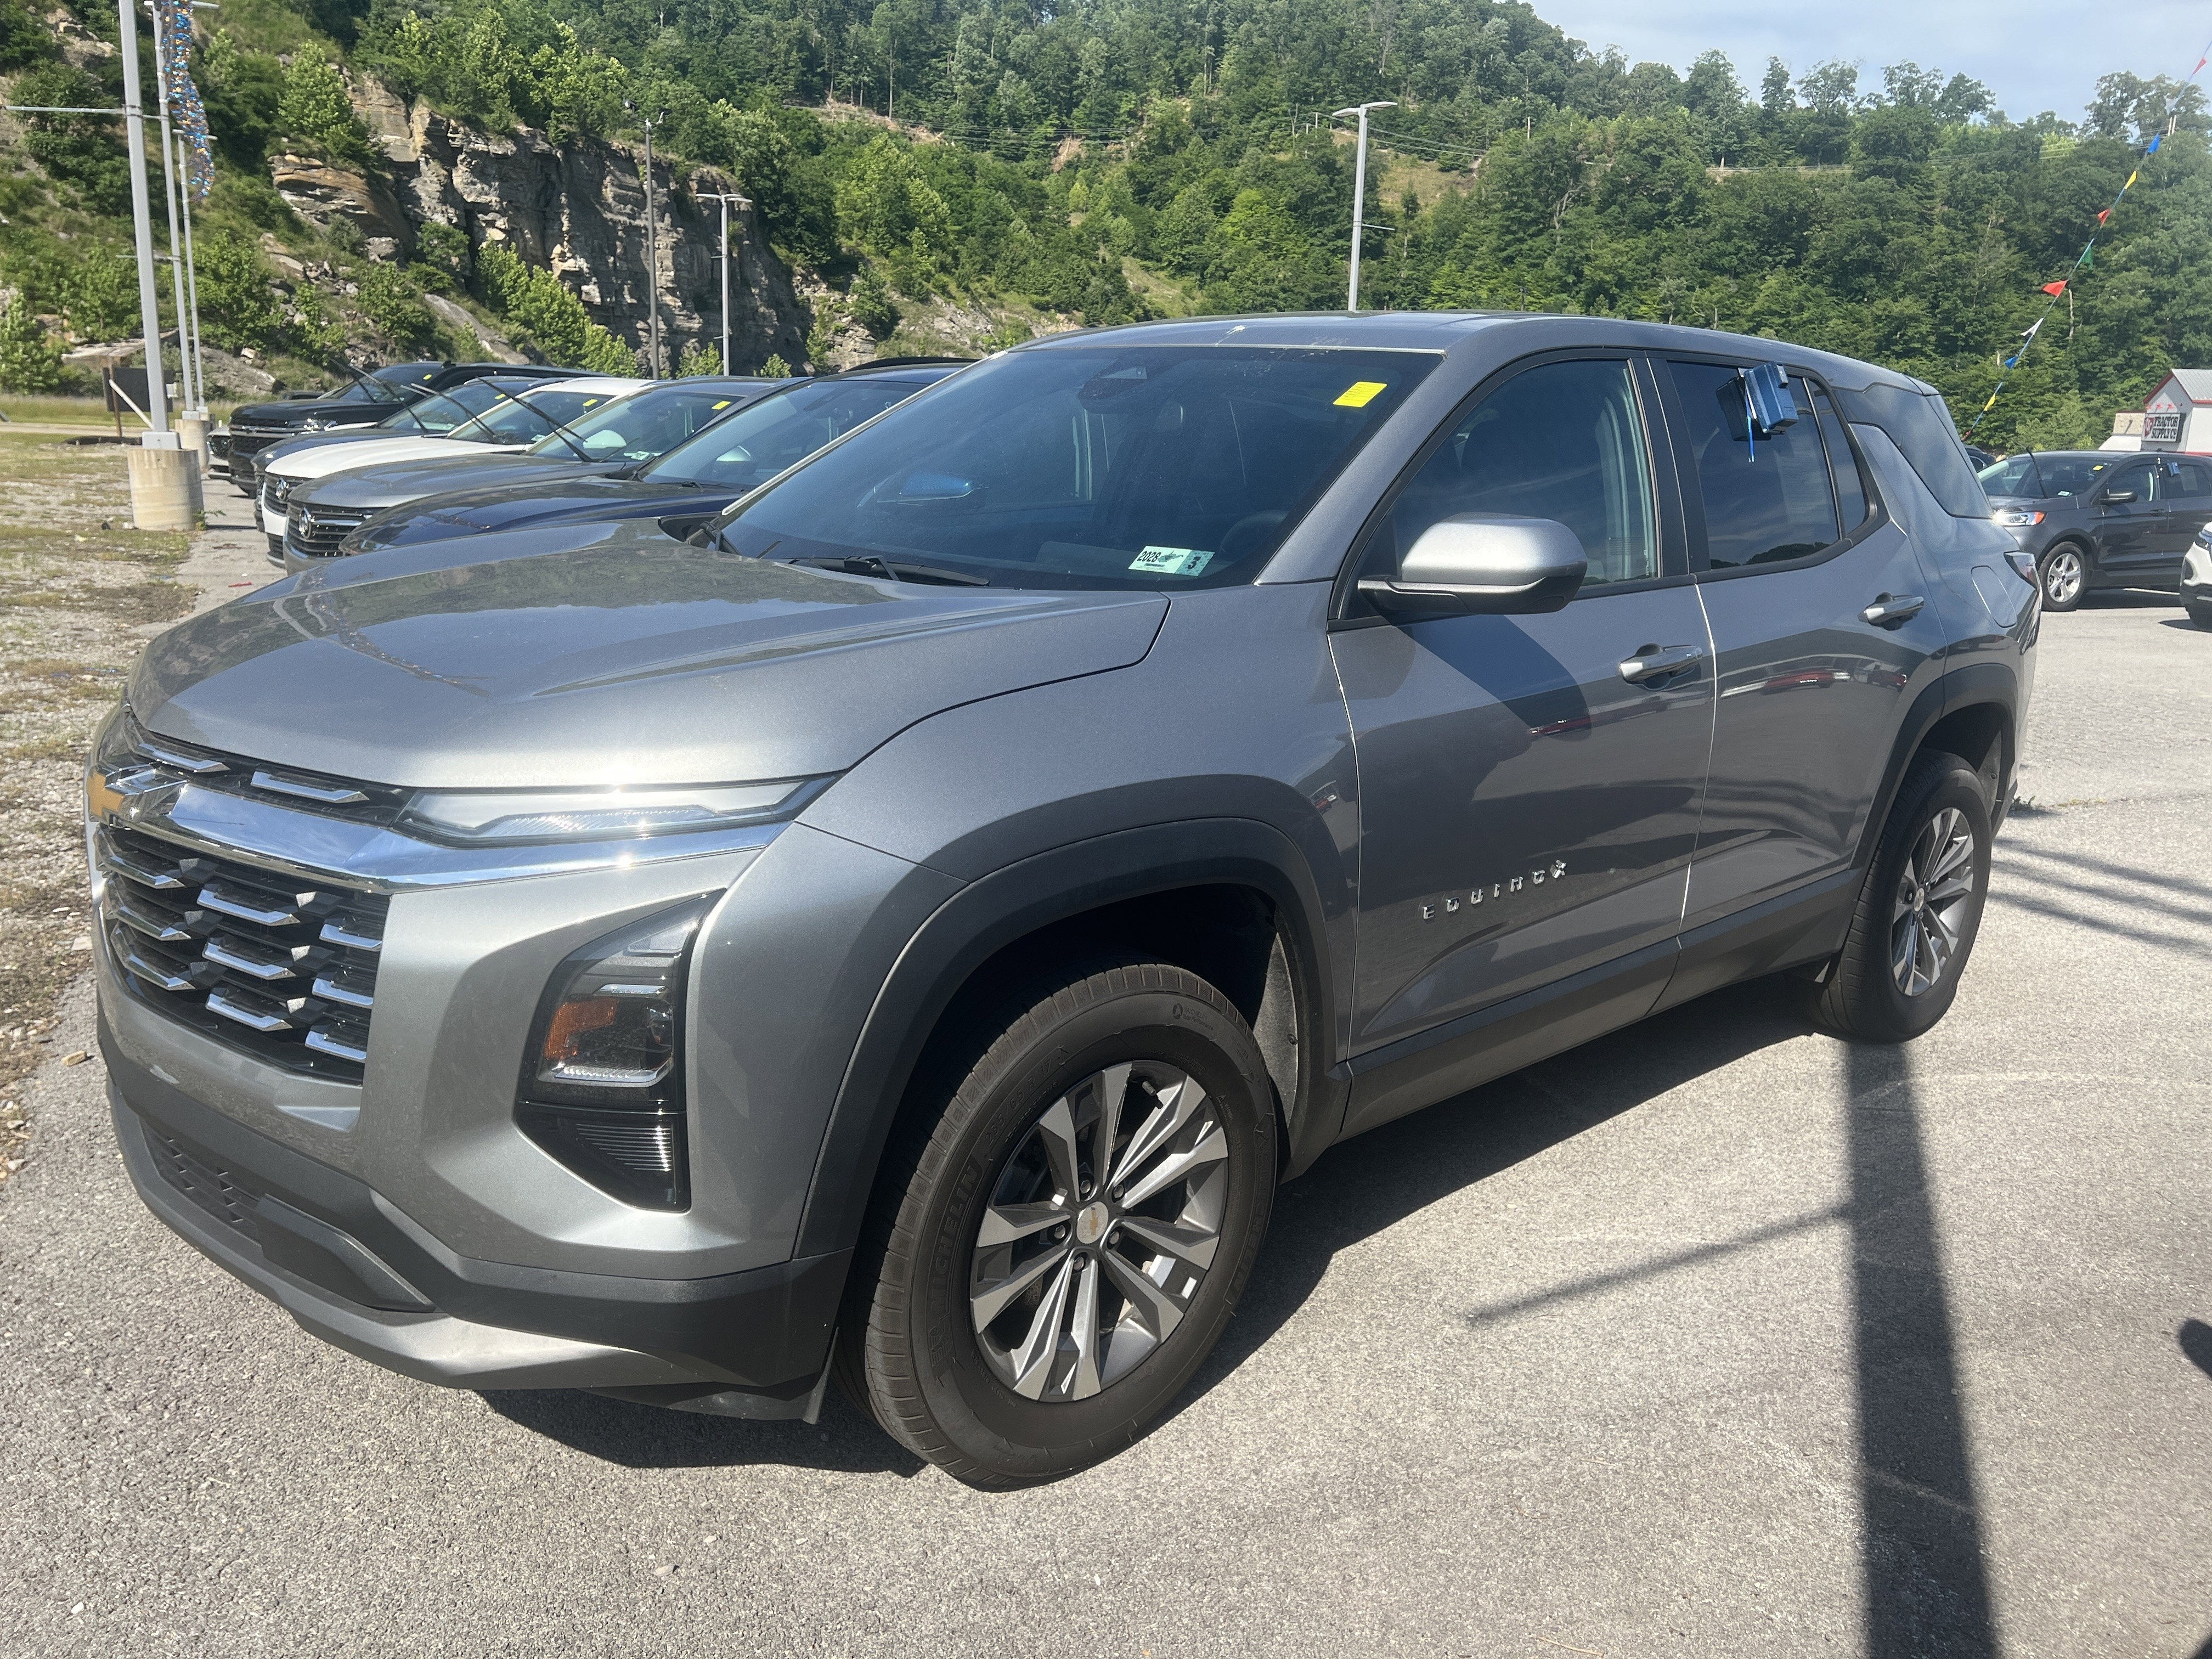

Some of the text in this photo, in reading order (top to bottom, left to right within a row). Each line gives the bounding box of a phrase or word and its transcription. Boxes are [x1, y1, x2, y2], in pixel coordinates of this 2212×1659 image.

[2154, 416, 2179, 427] TRACTOR
[2151, 428, 2170, 439] SUPPLY
[1136, 550, 1201, 570] 2028 3
[1423, 859, 1566, 920] EQUINOX
[931, 1165, 979, 1313] MICHELIN
